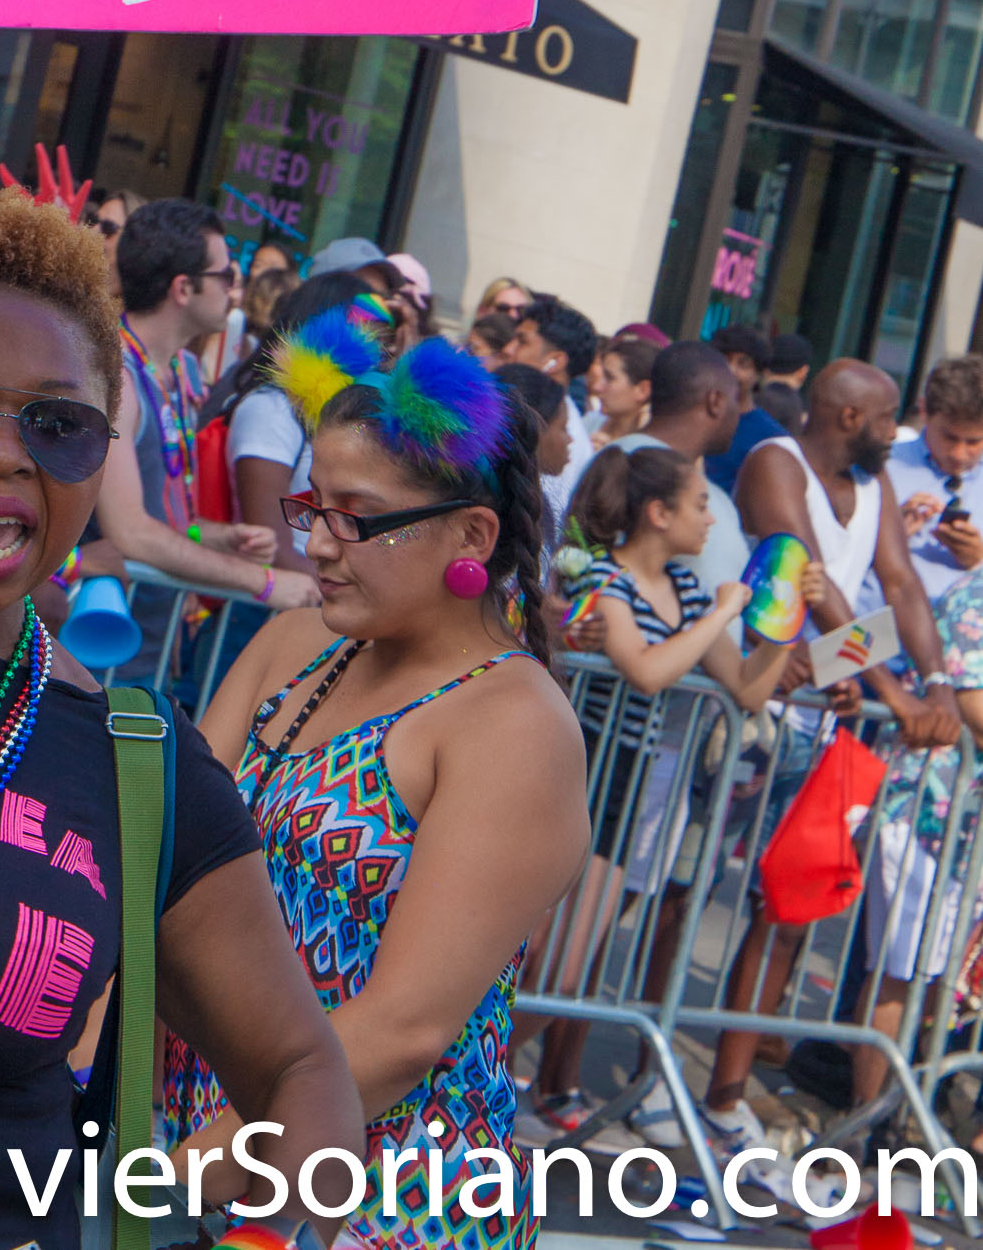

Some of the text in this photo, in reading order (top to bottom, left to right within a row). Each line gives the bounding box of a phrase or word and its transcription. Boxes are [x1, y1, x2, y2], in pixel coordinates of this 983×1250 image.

[242, 97, 370, 155] ALL YOU
[234, 142, 310, 189] NEED
